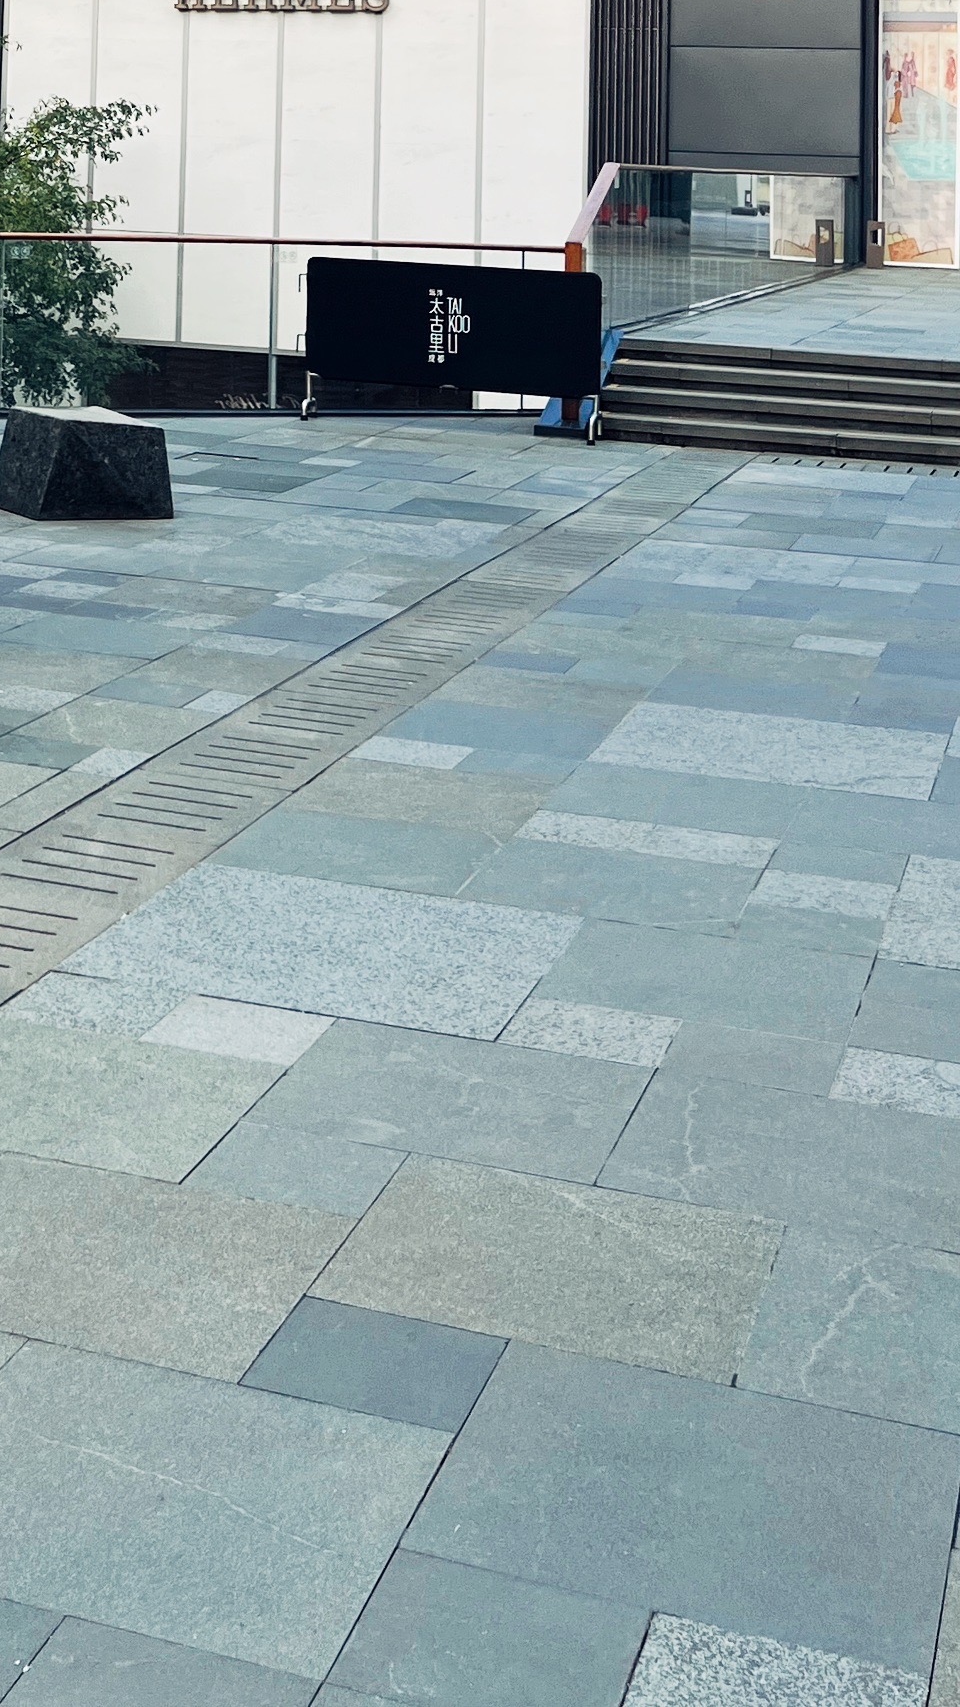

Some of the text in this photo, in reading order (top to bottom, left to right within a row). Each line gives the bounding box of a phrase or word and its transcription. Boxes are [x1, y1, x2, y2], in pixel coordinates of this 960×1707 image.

[446, 296, 463, 315] TAI
[428, 297, 445, 353] 太古里
[448, 314, 471, 334] KOO
